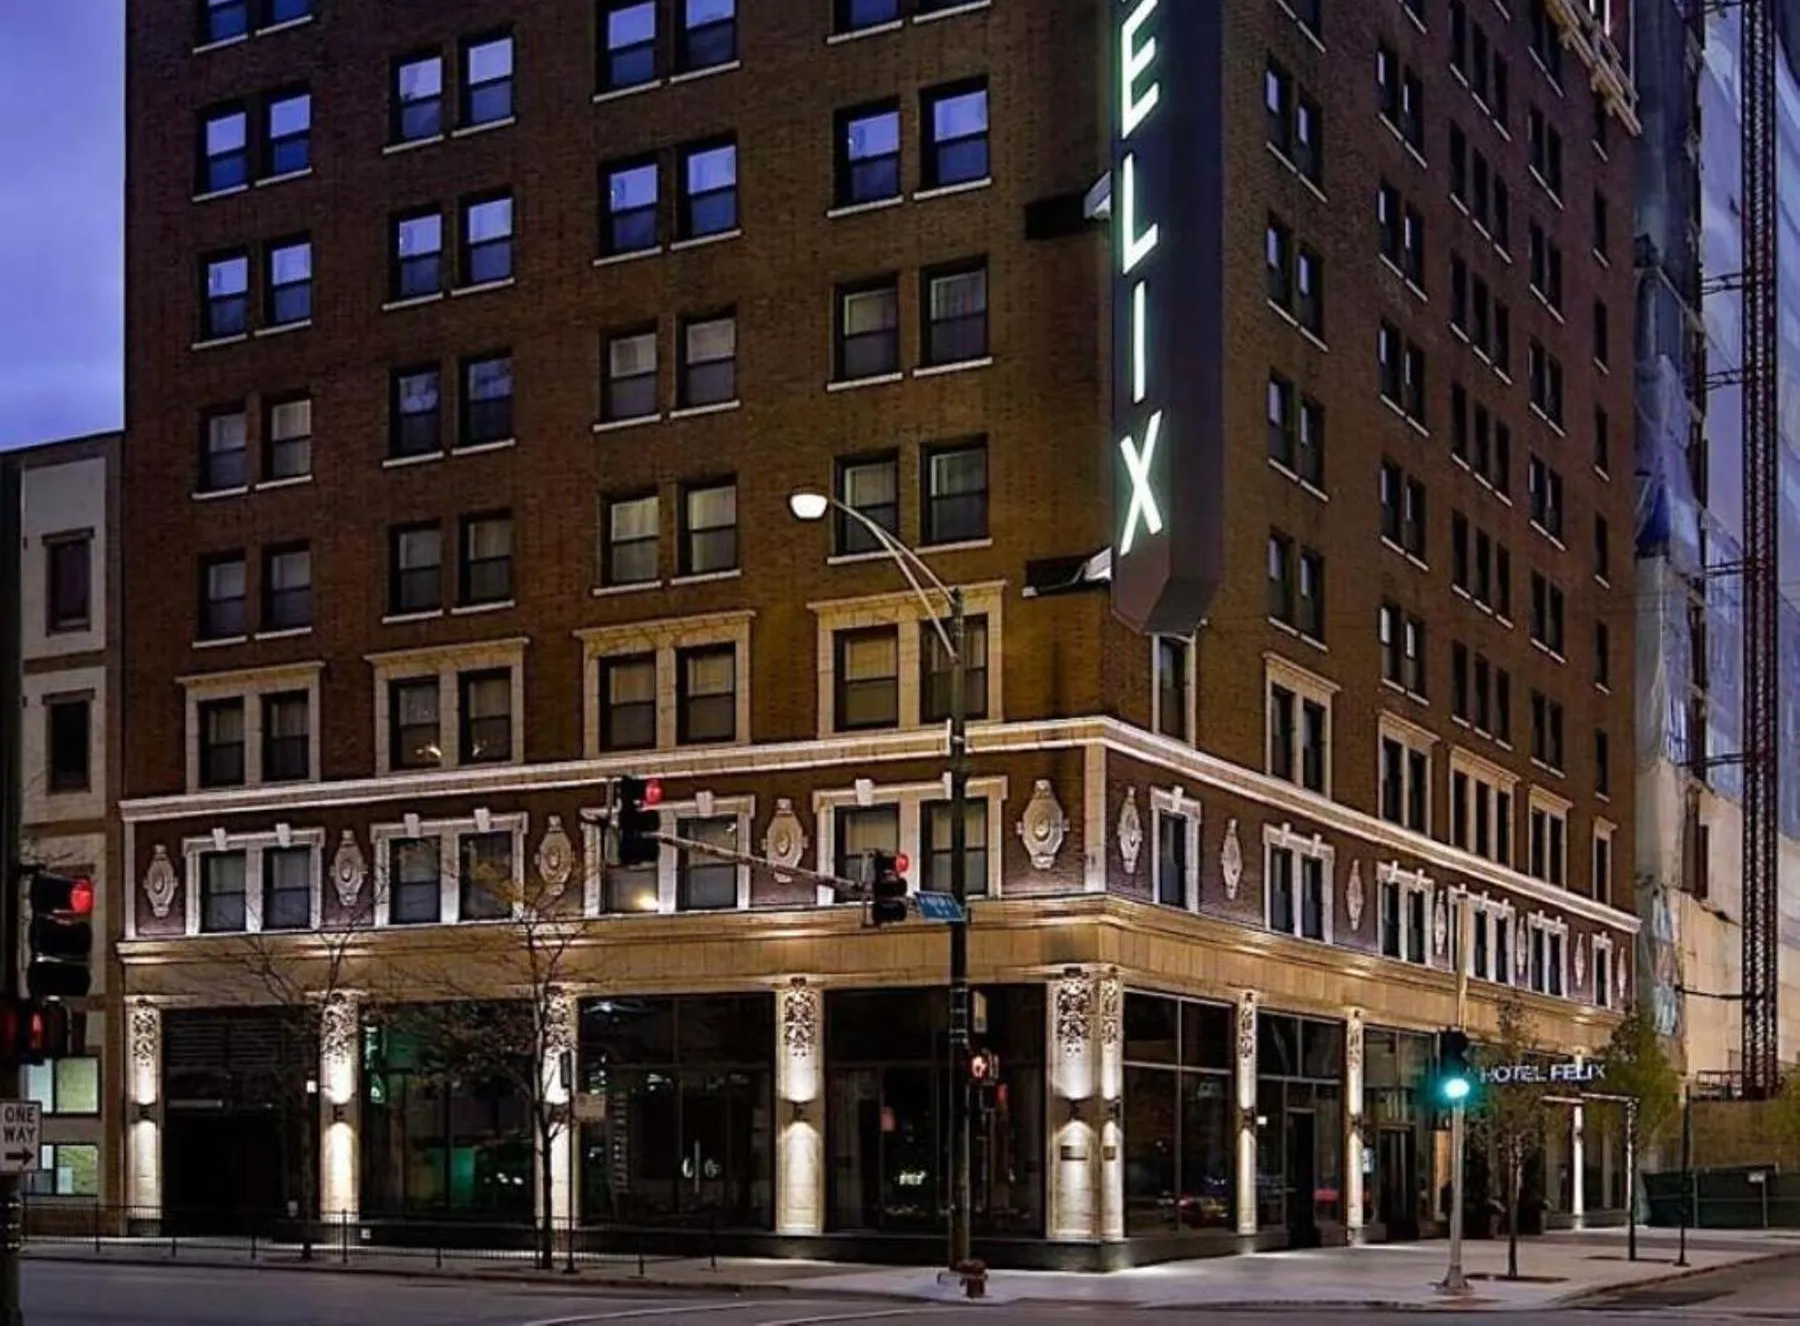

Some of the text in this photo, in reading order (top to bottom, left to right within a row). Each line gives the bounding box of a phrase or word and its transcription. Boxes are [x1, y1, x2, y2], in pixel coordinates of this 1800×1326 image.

[1480, 1063, 1605, 1083] HOTEL FELIX
[4, 1106, 35, 1123] ONE
[3, 1125, 37, 1144] WAY
